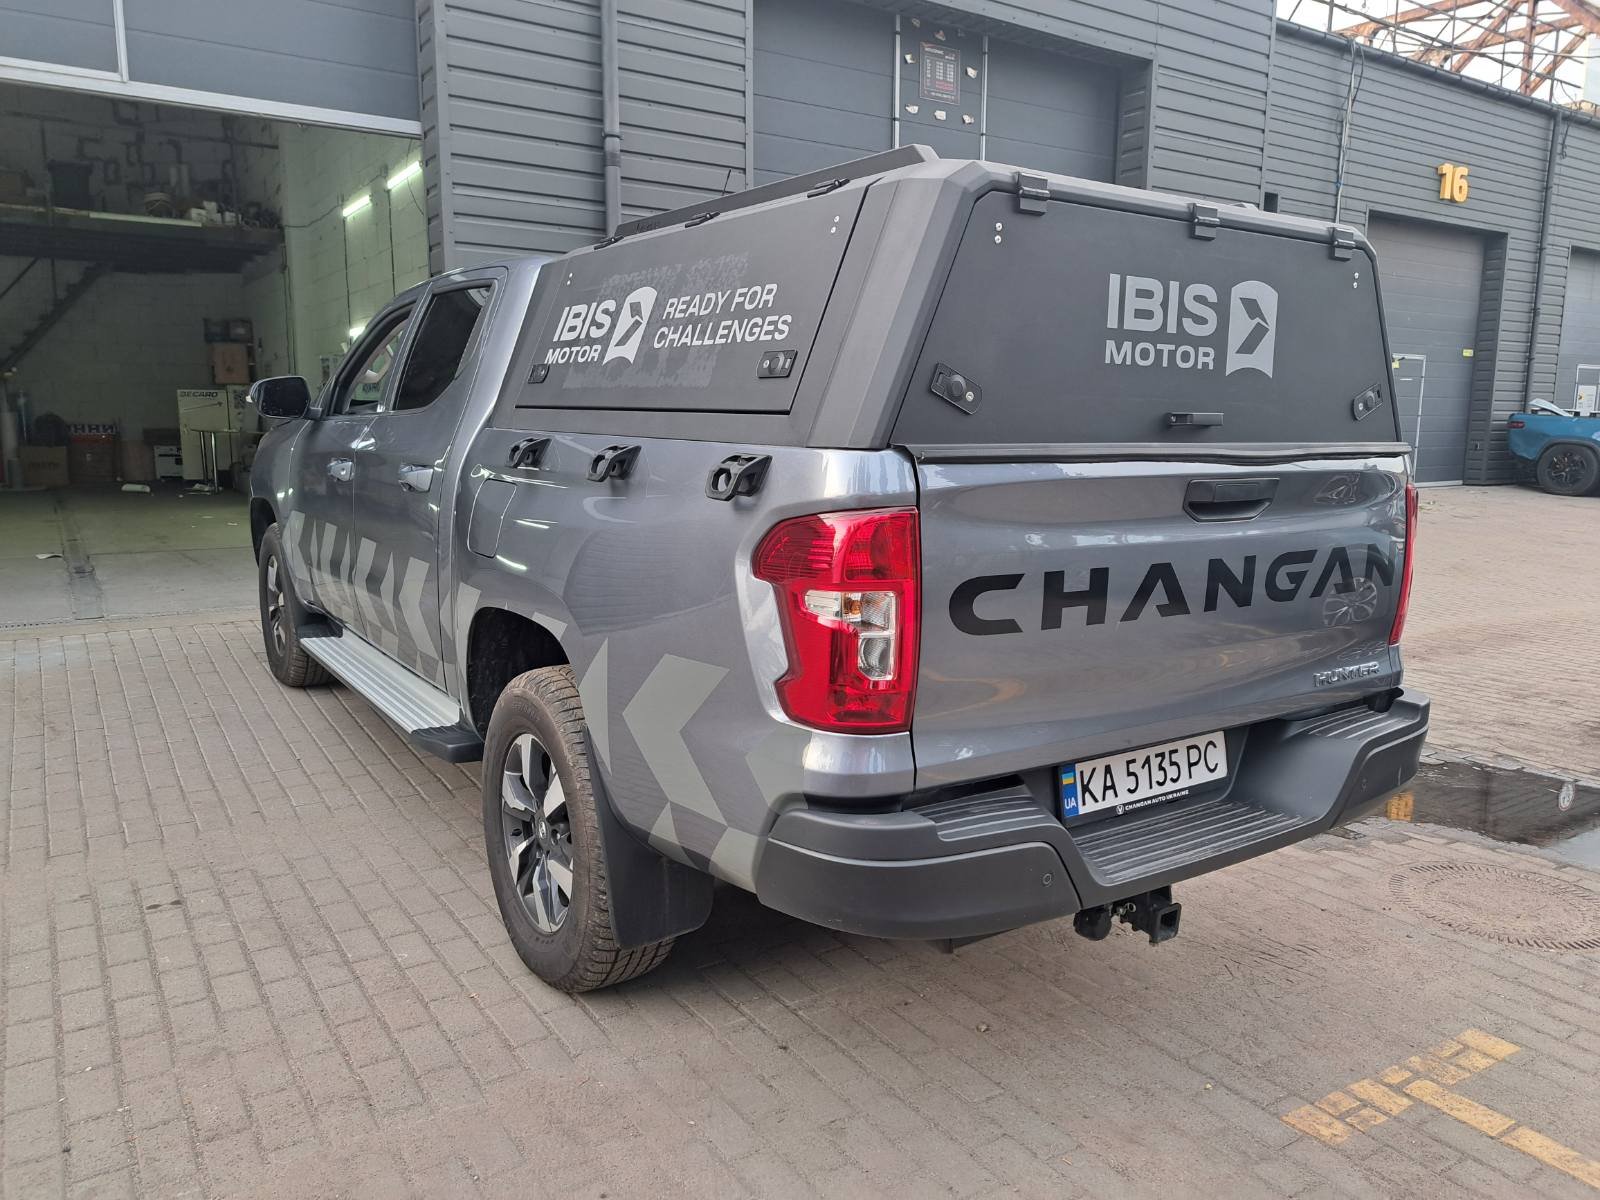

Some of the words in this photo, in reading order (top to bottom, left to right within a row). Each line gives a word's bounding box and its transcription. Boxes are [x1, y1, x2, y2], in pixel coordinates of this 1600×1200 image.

[1437, 163, 1469, 203] 16
[662, 290, 732, 320] READY
[730, 283, 778, 313] FOR
[1106, 273, 1219, 337] IBIS
[553, 299, 617, 343] IBIS
[653, 314, 793, 350] CHALLENGES
[545, 344, 602, 366] MOTOR
[1104, 339, 1216, 370] MOTOR
[948, 543, 1396, 636] CHANGAN
[1312, 661, 1379, 688] HUNTER
[1079, 764, 1119, 807] KA
[1125, 748, 1182, 795] 5135
[1186, 740, 1219, 780] PC
[1064, 797, 1077, 810] UA
[1151, 795, 1166, 804] AUTO
[1165, 789, 1190, 800] UKRAINE
